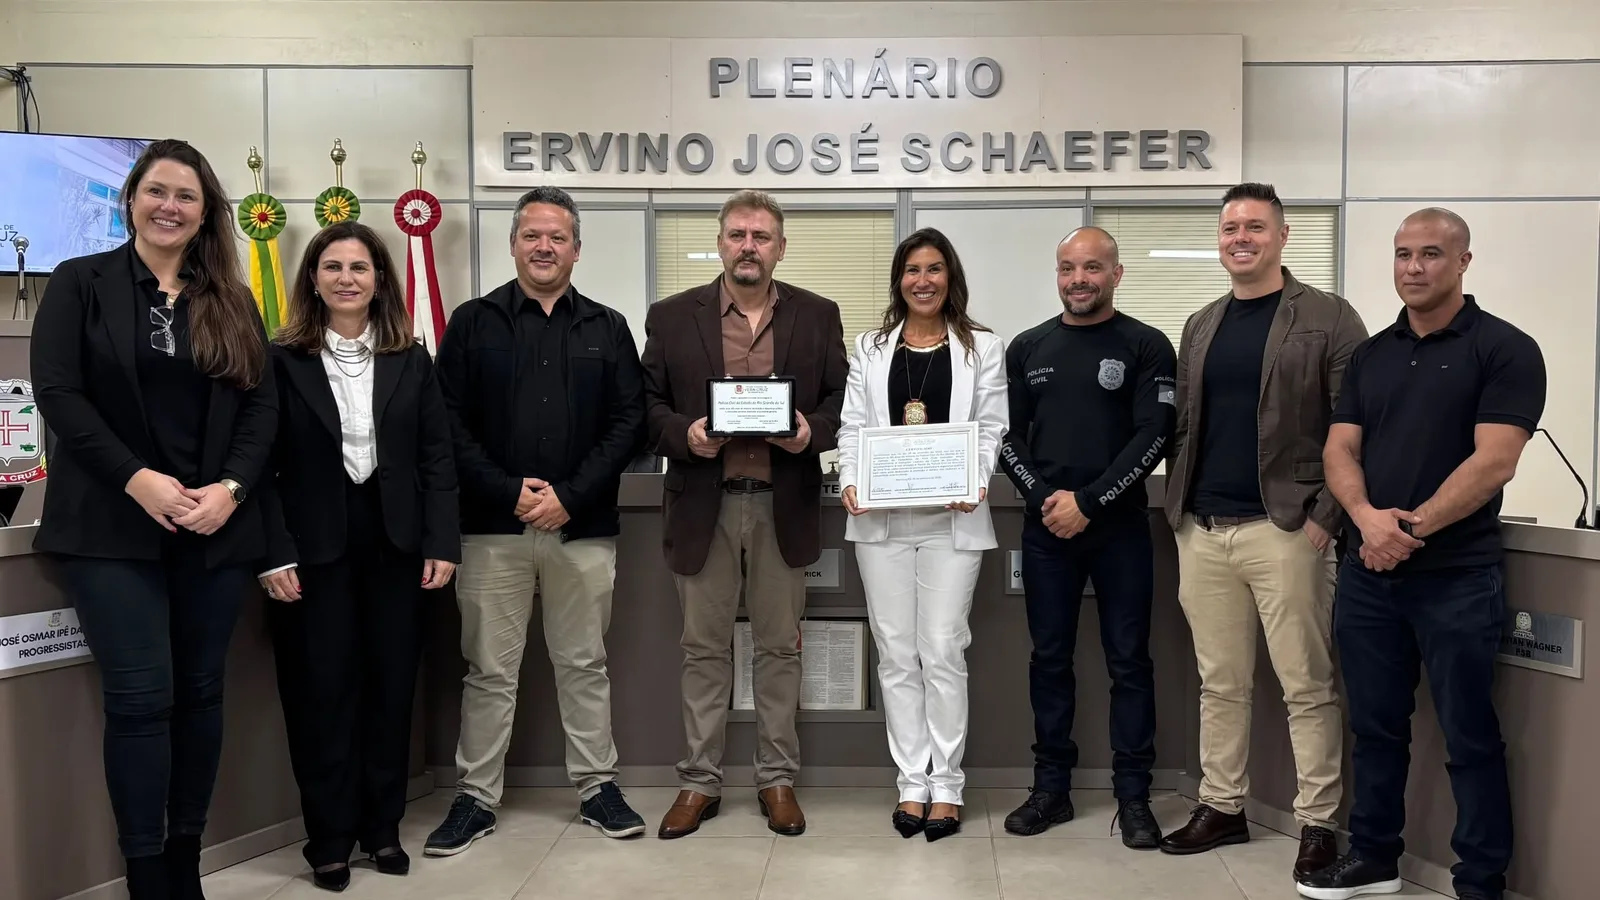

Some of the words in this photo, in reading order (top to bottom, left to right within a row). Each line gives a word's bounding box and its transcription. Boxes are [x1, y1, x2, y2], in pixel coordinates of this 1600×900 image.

[709, 48, 1003, 98] PLENÁRIO
[503, 131, 714, 173] ERVINO
[733, 122, 879, 173] JOSÉ
[900, 129, 1212, 172] SCHAEFER
[1027, 367, 1054, 378] POLÍCIA
[1030, 376, 1048, 385] CIVIL
[9, 470, 38, 481] CRUZ
[1013, 463, 1036, 490] CIVIL
[1099, 467, 1144, 505] POLÍCIA
[1141, 436, 1166, 467] CIVIL
[21, 630, 56, 643] OSMAR
[57, 625, 69, 637] IPÊ
[19, 640, 88, 658] PROGRESSISTAS
[1526, 639, 1562, 654] WAGNER
